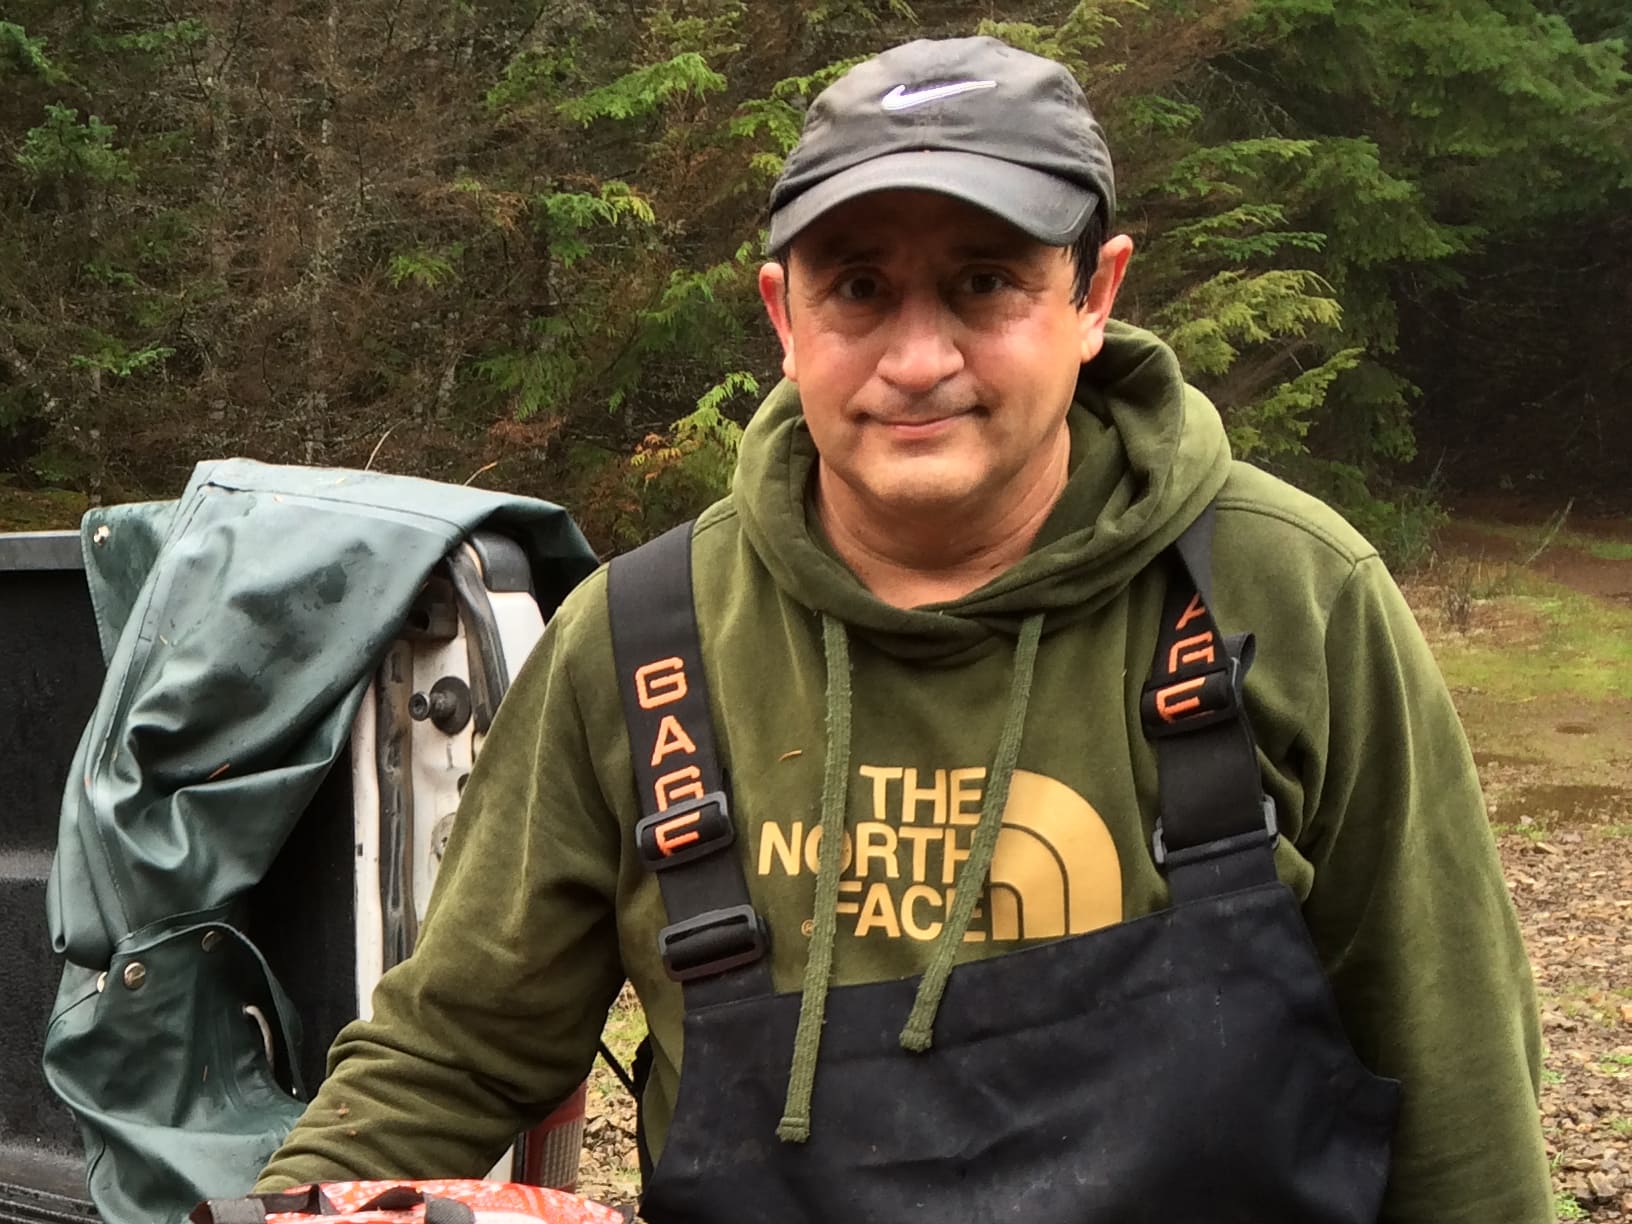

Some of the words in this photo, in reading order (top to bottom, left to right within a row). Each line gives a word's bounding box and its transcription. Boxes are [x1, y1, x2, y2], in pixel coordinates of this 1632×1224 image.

[859, 765, 987, 824] THE
[758, 821, 978, 883] NORTH
[833, 881, 987, 942] FACE
